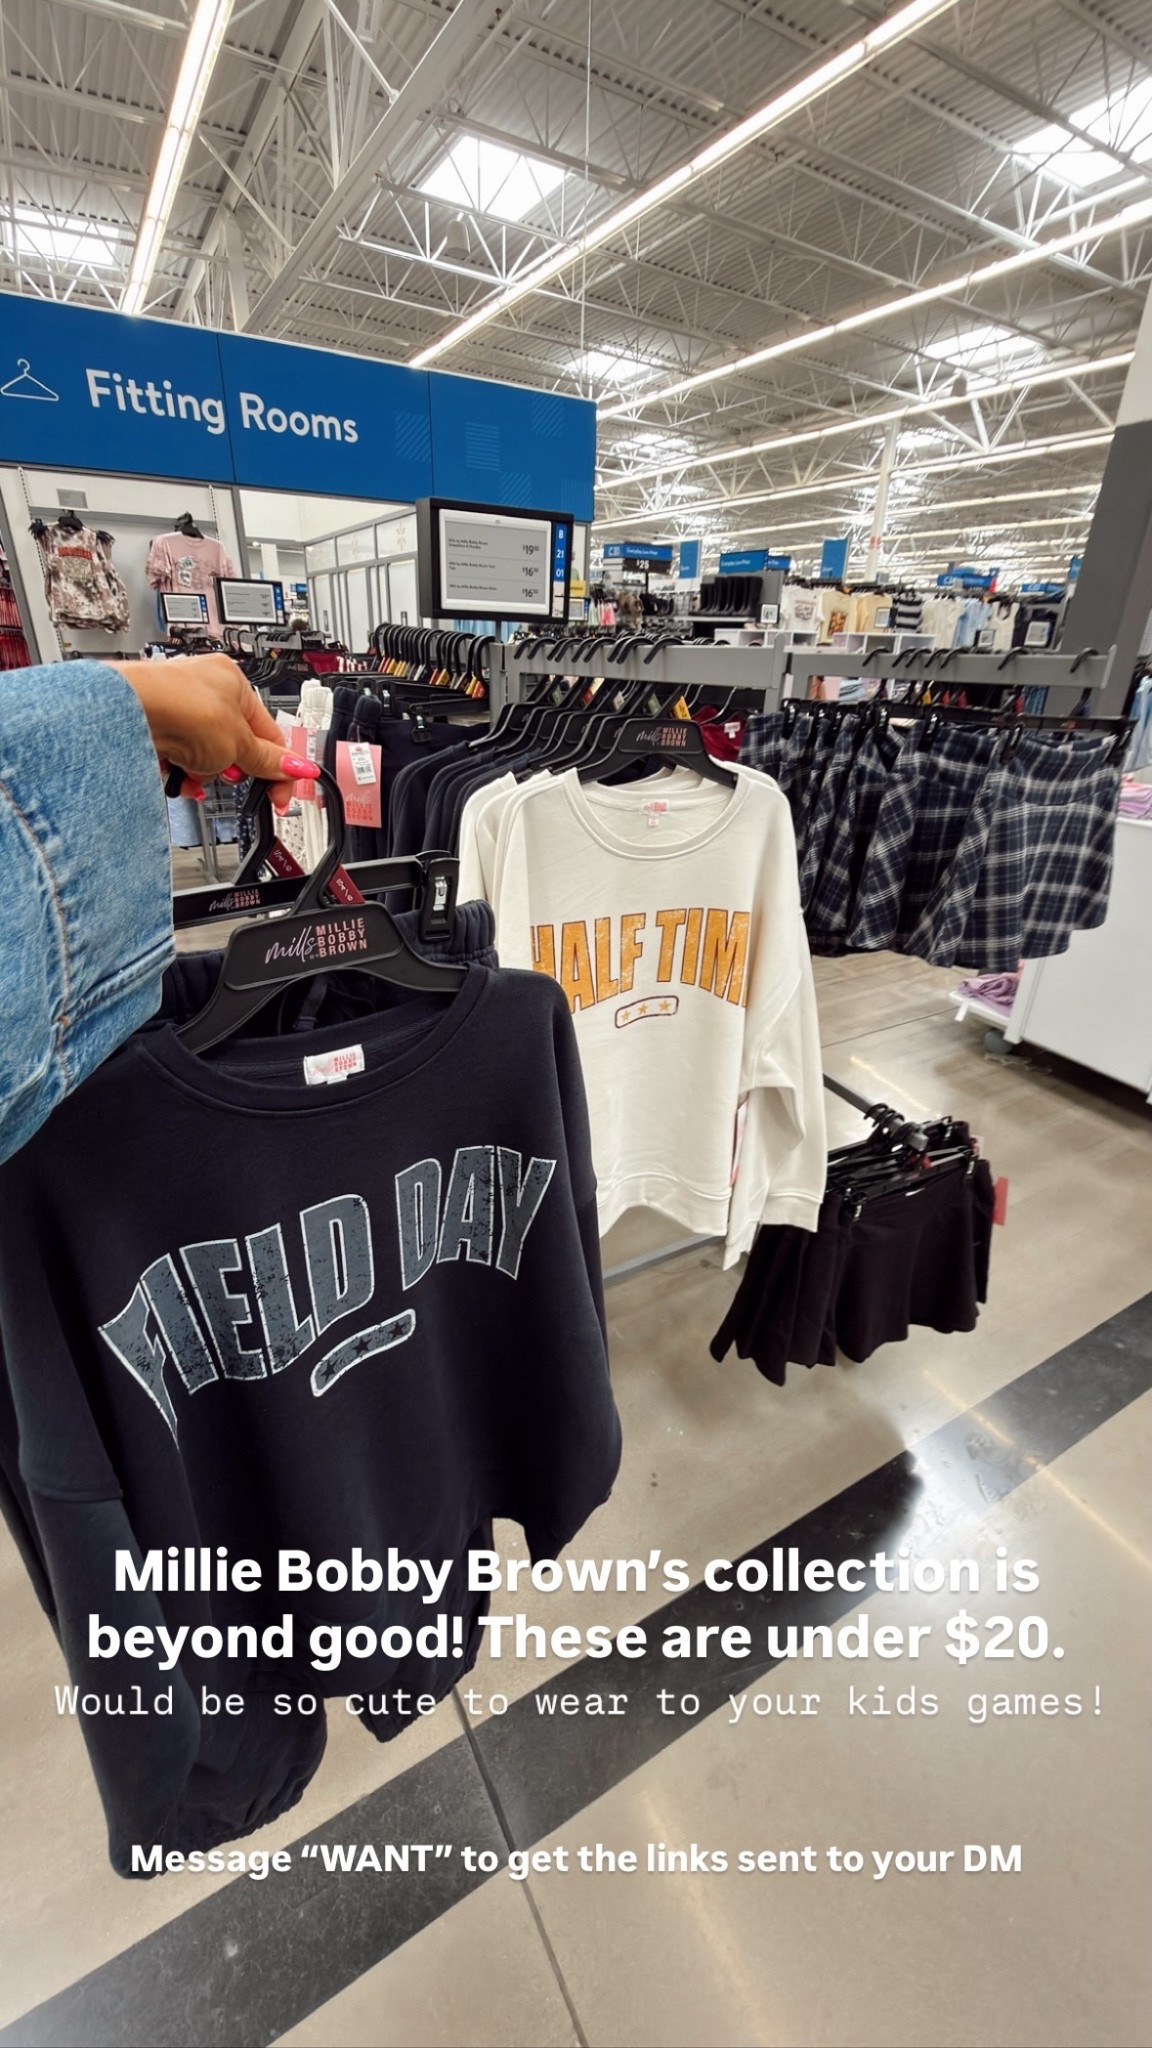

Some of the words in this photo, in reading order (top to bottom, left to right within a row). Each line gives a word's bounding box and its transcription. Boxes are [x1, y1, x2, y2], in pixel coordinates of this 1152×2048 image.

[86, 368, 226, 435] Fitting
[240, 391, 359, 443] Rooms
[556, 549, 564, 558] 21
[555, 568, 564, 578] 01
[315, 917, 365, 936] MILLIE
[265, 925, 318, 964] mills
[317, 928, 365, 947] BOBBY
[318, 938, 367, 958] BROWN
[530, 912, 646, 1014] HALF
[655, 907, 751, 1008] TIM
[97, 1193, 375, 1451] FIELD
[395, 1145, 557, 1291] DAY
